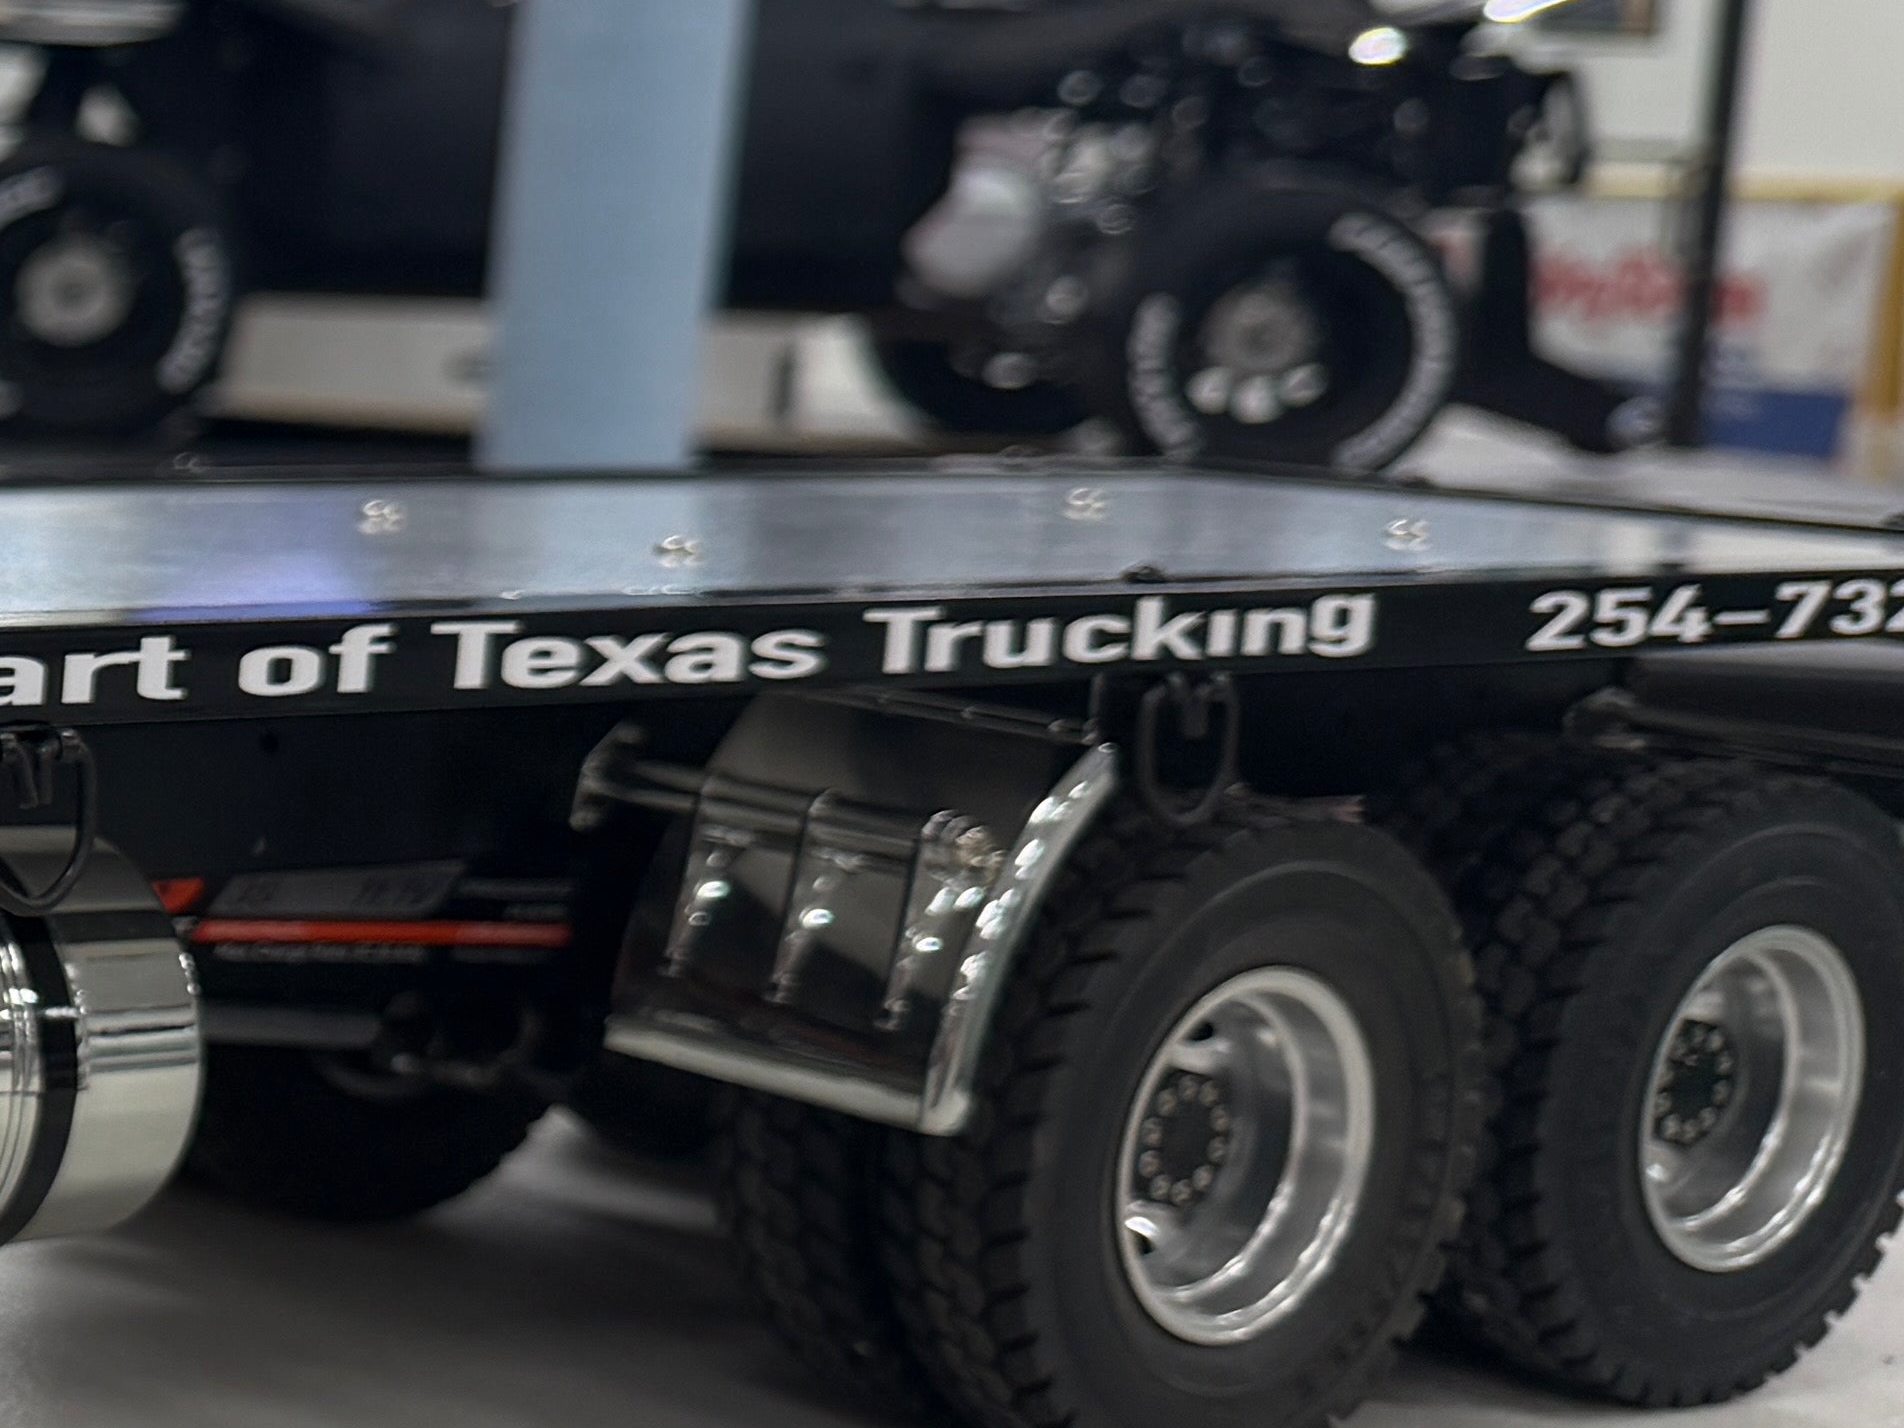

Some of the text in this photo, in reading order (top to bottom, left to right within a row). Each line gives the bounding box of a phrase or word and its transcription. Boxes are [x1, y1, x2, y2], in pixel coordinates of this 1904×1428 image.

[237, 622, 398, 697] of
[429, 619, 828, 690] Texas
[862, 592, 1376, 675] Trucking
